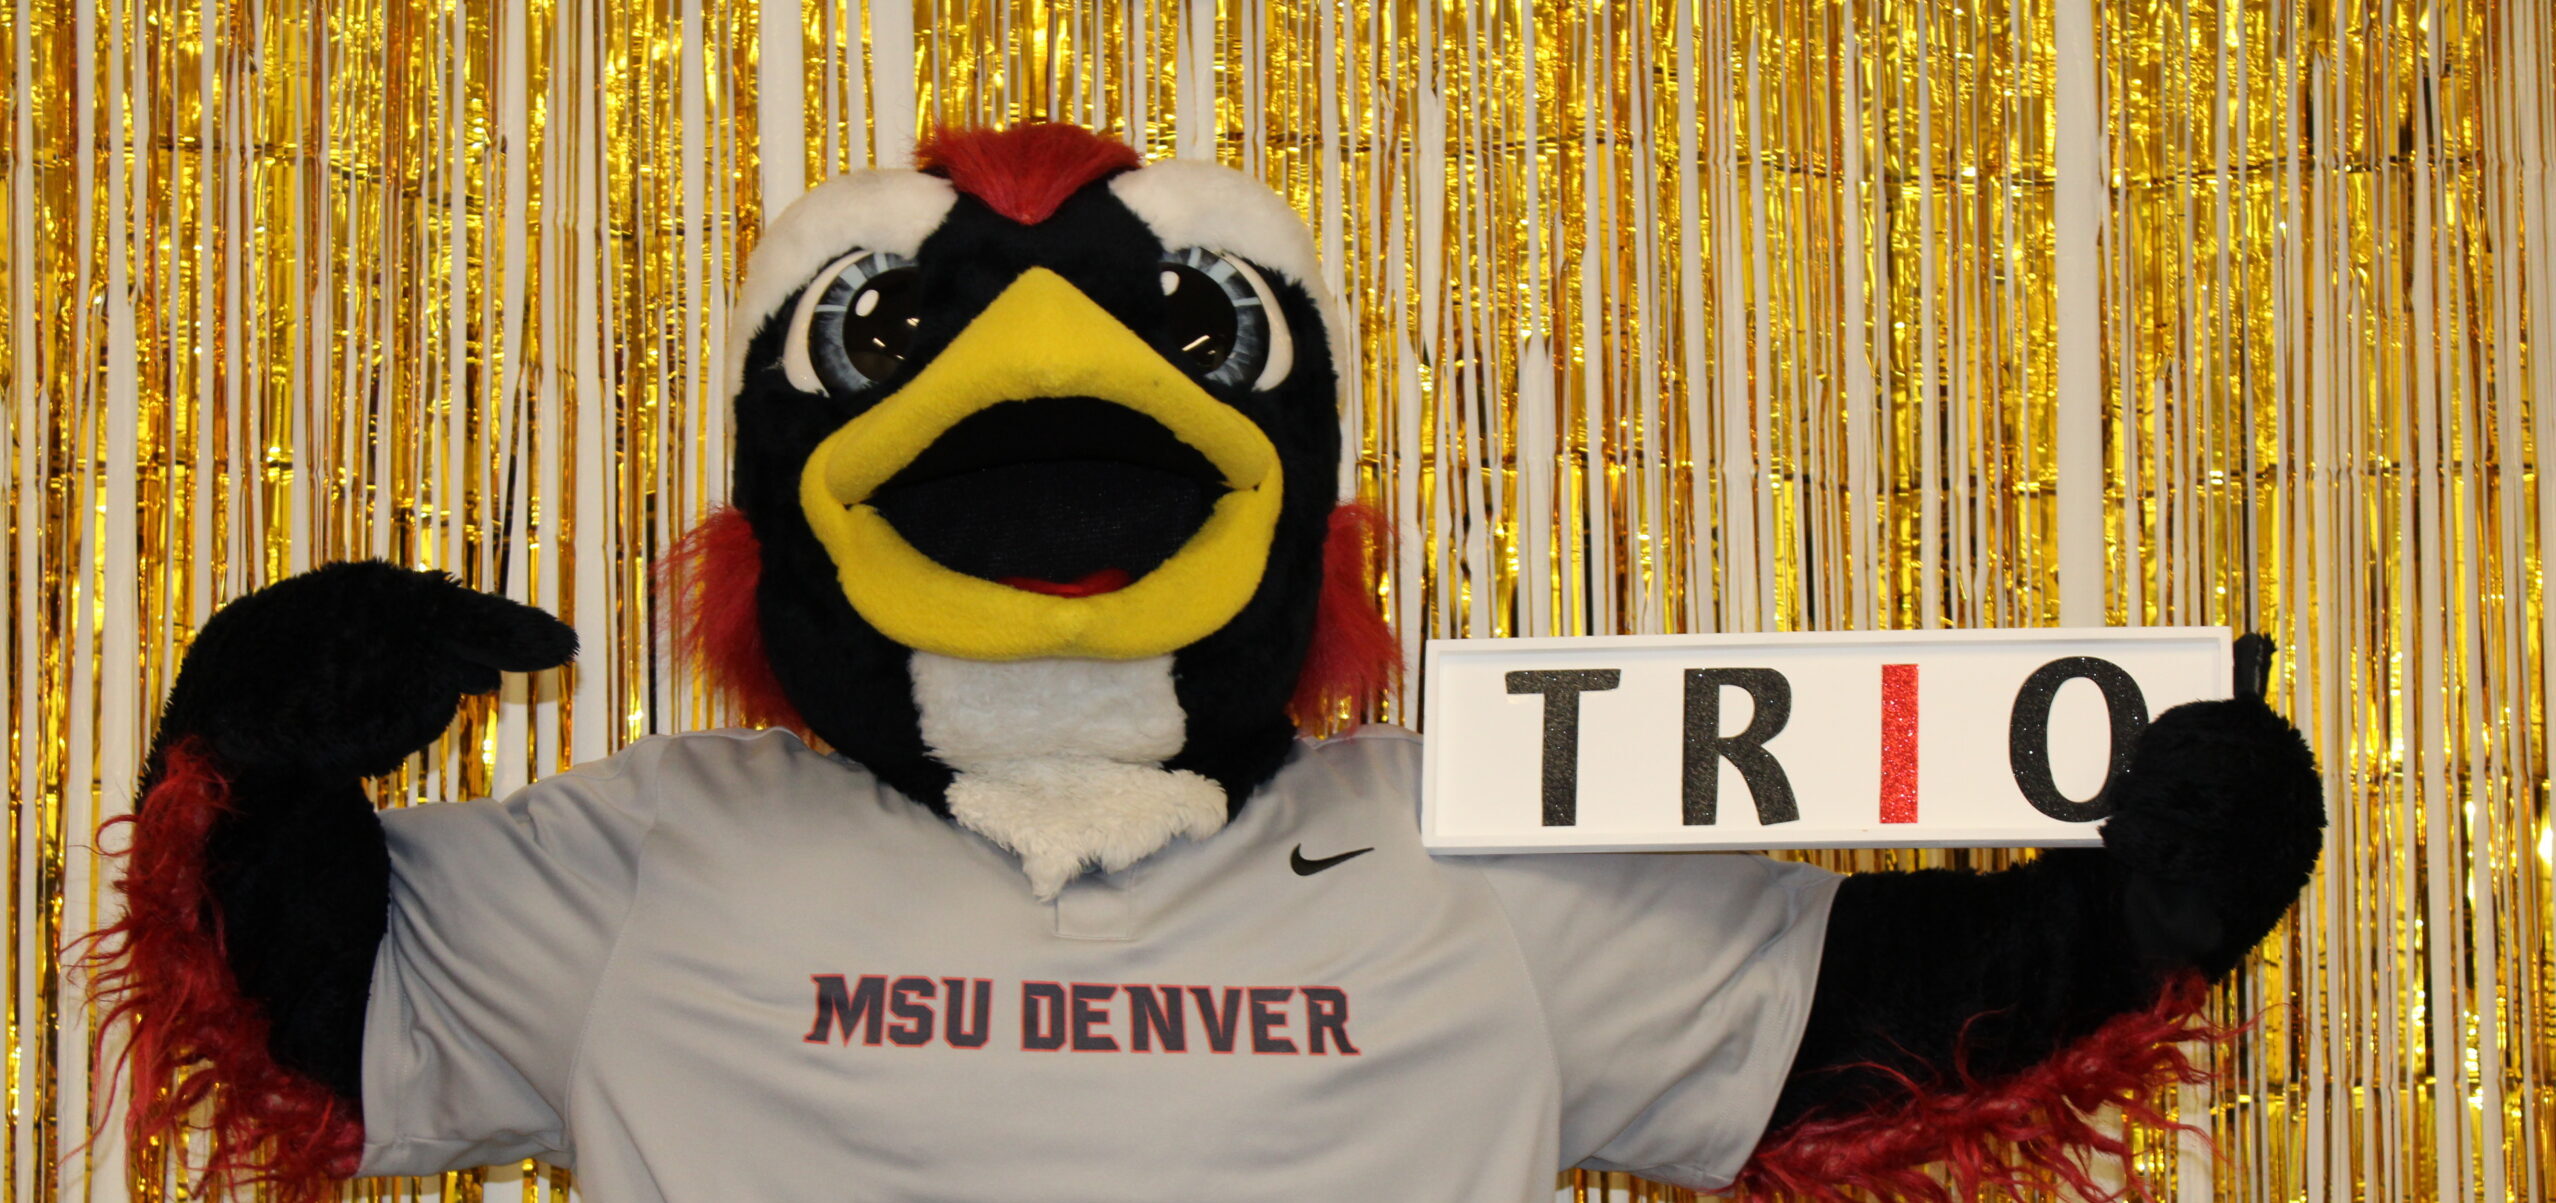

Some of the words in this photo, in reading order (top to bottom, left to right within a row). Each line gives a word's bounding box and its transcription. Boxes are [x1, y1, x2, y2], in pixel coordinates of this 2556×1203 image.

[1504, 656, 2150, 826] TRIO
[803, 974, 993, 1049] MSU
[1020, 980, 1361, 1055] DENVER
